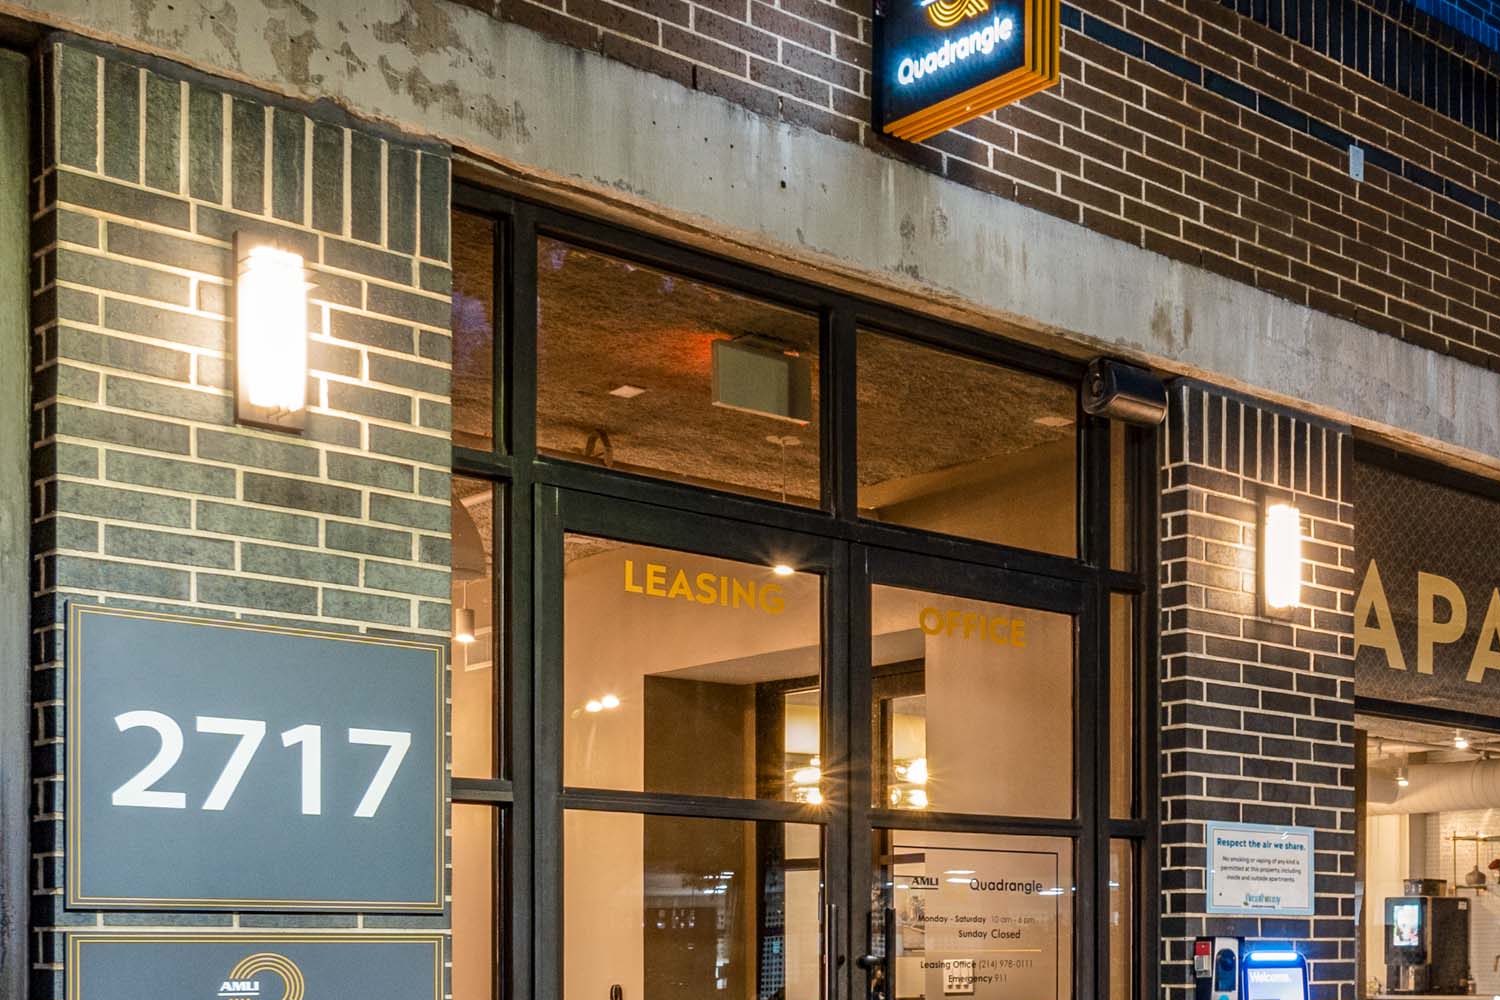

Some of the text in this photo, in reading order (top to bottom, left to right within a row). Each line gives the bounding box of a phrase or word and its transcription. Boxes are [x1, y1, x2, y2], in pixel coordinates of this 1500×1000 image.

[897, 17, 1013, 85] Quadrangle
[624, 559, 786, 615] LEASING
[919, 606, 1026, 648] OFFICE
[112, 710, 412, 818] 2717
[1217, 837, 1247, 848] Respect
[1248, 839, 1260, 848] the
[1285, 841, 1305, 850] share.
[911, 876, 1043, 894] AMLI Quadrangle
[918, 915, 948, 923] Monday
[955, 915, 986, 924] Saturday
[958, 929, 1021, 939] Sunday Closed
[920, 960, 950, 970] Leasing
[953, 960, 976, 968] Office
[979, 960, 998, 970] (214)
[948, 974, 1007, 984] Emergency 911
[1249, 971, 1291, 983] Welco
[219, 981, 260, 991] AMLI
